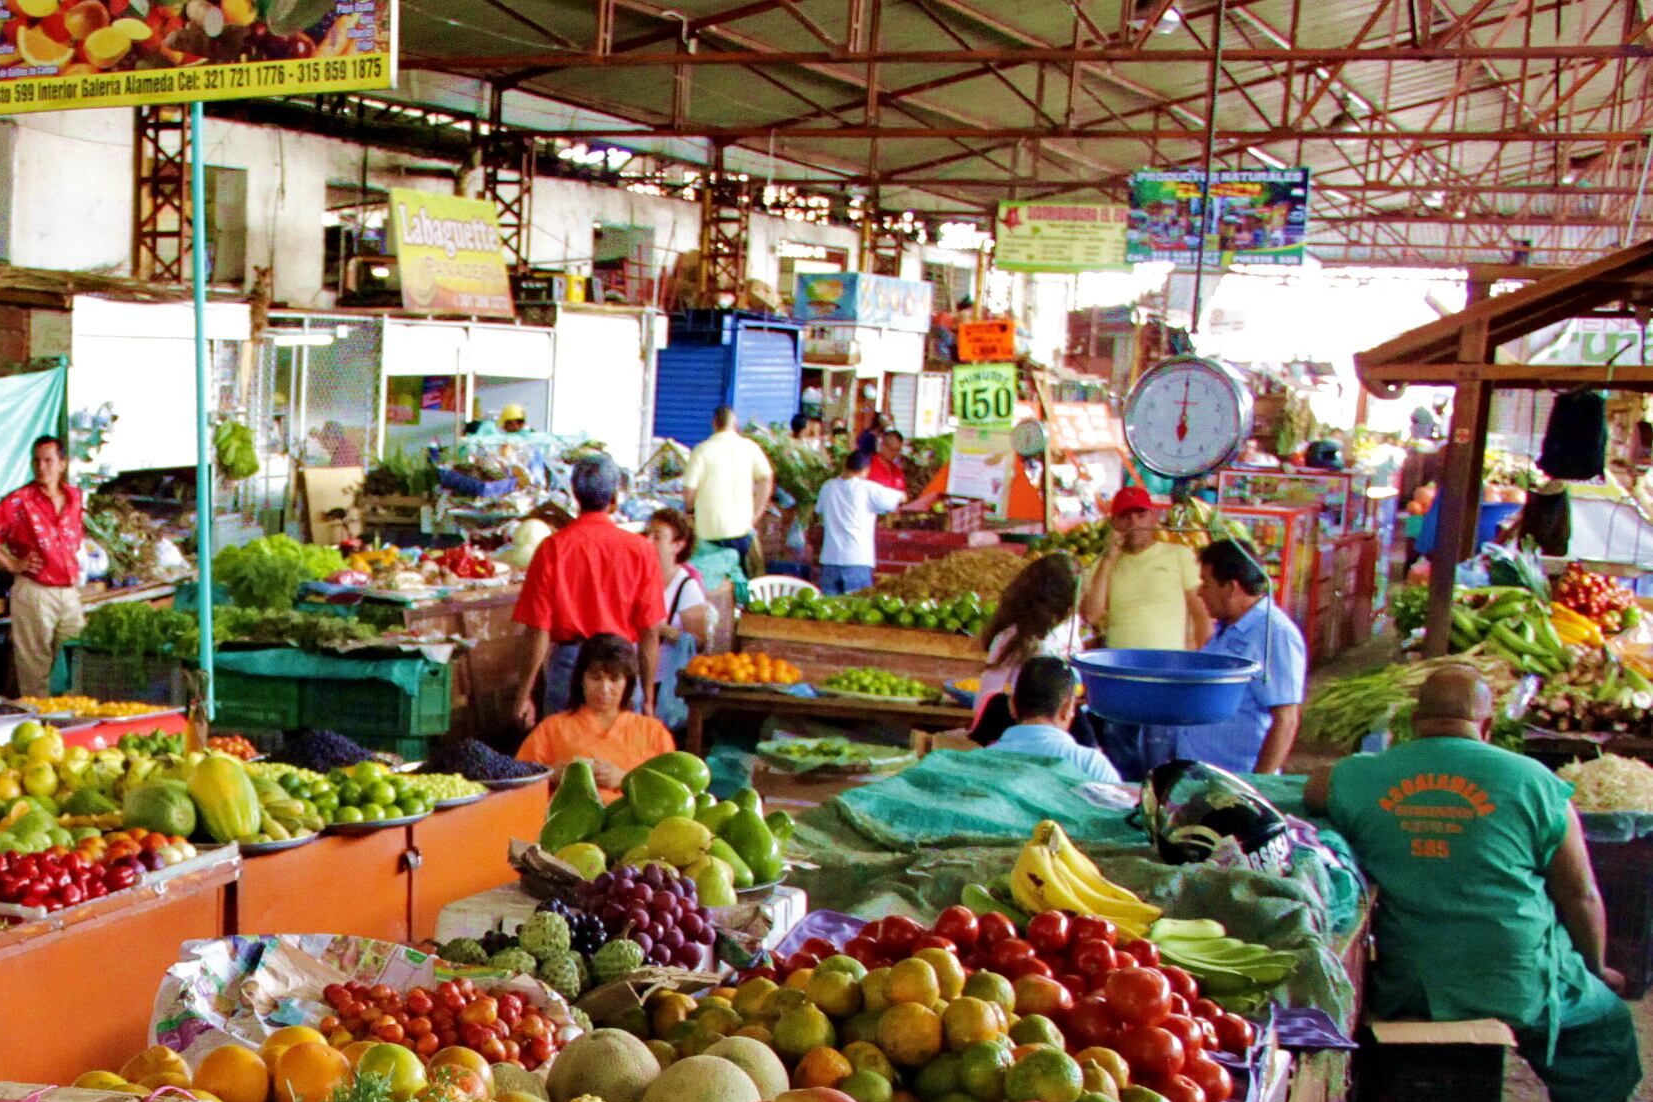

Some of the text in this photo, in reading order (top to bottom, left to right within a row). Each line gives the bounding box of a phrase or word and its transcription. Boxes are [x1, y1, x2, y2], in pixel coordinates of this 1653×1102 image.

[14, 83, 35, 102] 599
[38, 81, 78, 100] Interior
[81, 78, 121, 97] Galeria
[124, 72, 174, 95] Alameda
[178, 71, 200, 92] Cel:
[204, 69, 225, 89] 321
[230, 67, 251, 88] 721
[256, 65, 285, 86] 1776
[298, 62, 320, 83] 315
[325, 60, 347, 81] 859
[353, 58, 382, 79] 1875
[398, 203, 500, 258] Labaguette
[961, 387, 1012, 420] 150
